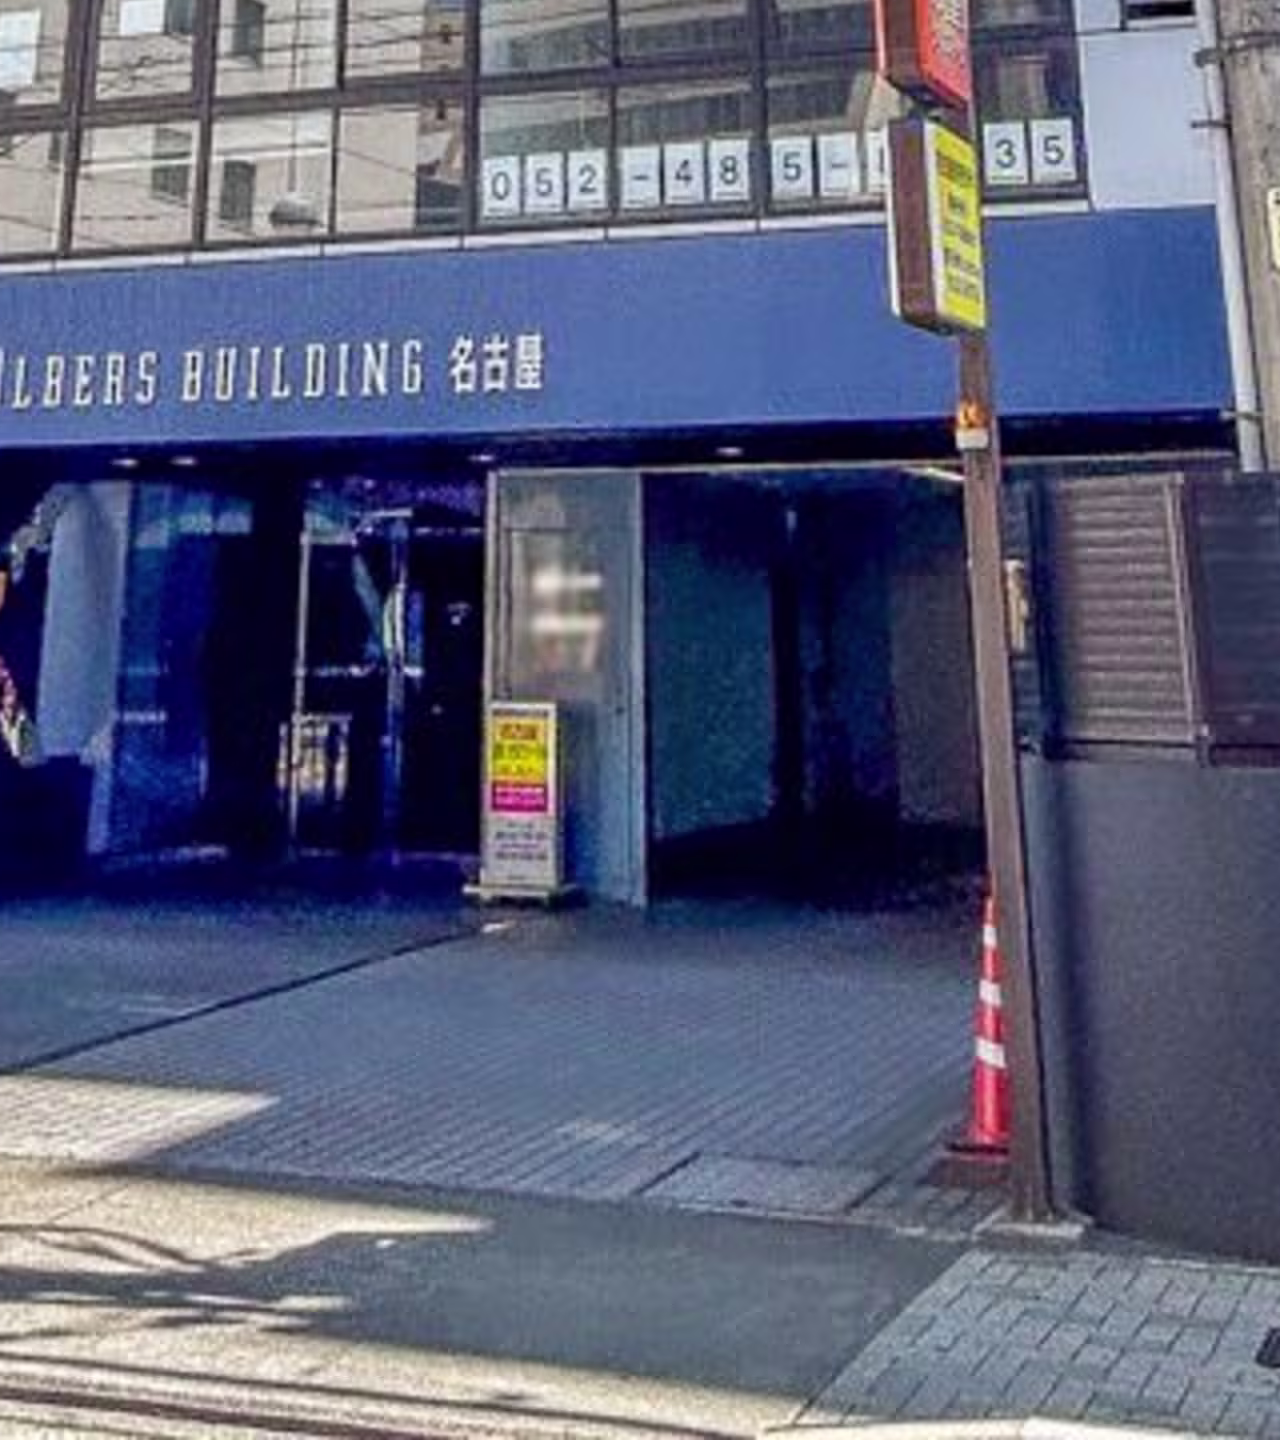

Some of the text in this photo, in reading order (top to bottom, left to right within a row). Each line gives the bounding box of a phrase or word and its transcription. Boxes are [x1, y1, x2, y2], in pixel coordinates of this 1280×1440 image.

[490, 134, 1066, 202] 052-485-35
[182, 338, 422, 402] BUILDING
[449, 333, 544, 393] 名古屋
